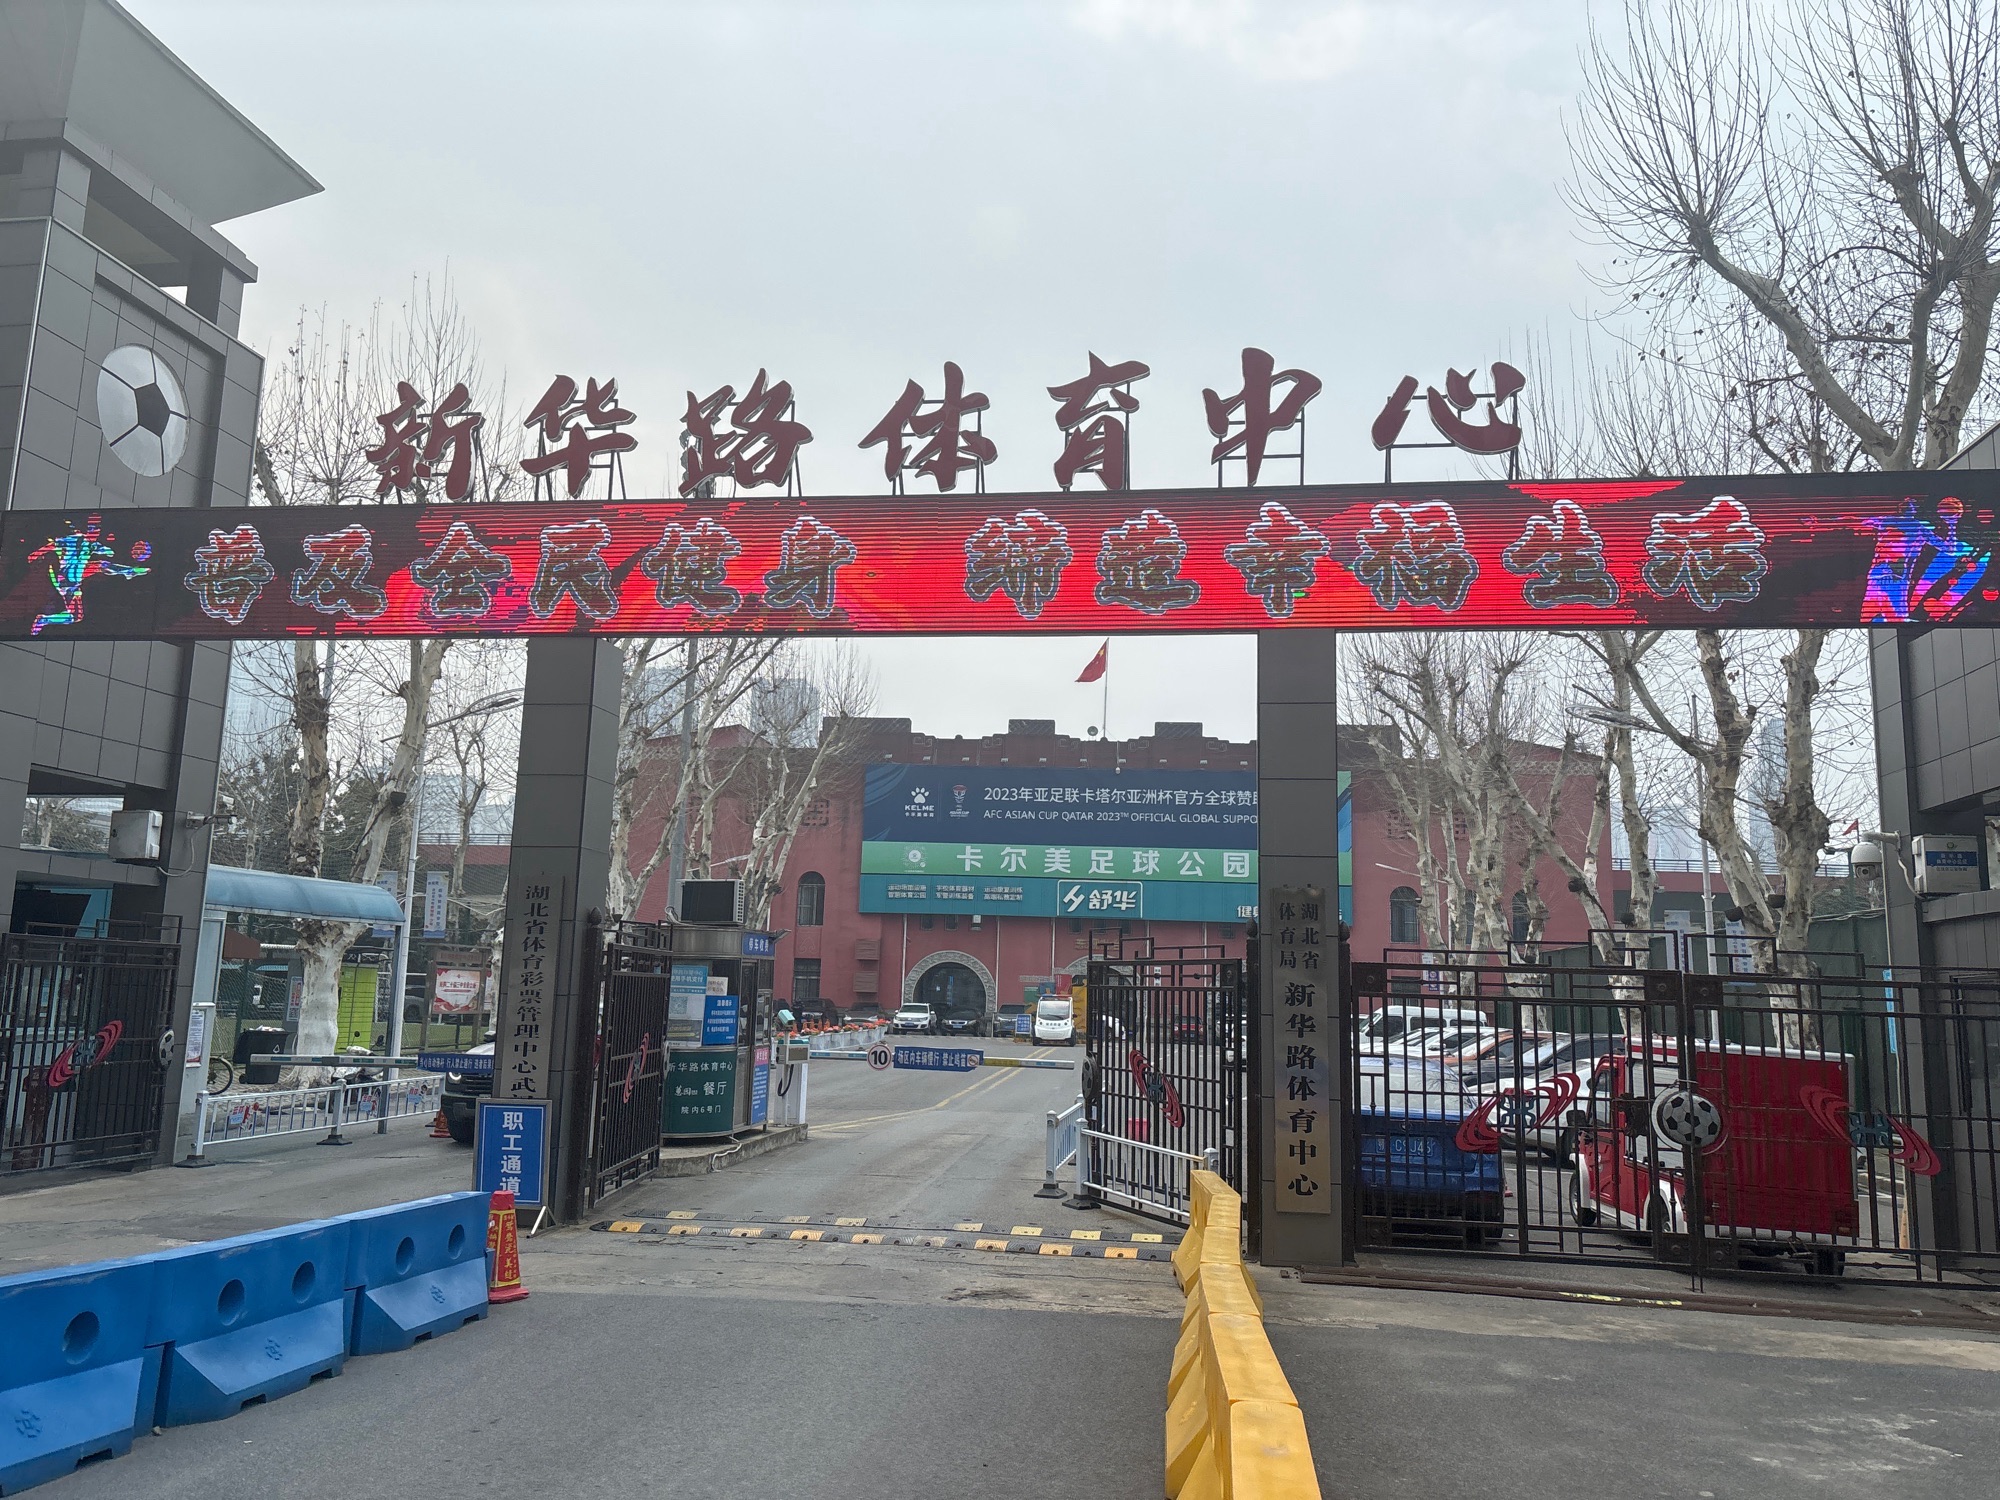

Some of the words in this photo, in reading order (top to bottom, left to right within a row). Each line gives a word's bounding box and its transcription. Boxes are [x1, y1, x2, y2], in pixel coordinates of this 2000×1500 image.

[366, 348, 1526, 500] 新华路体育中心
[186, 514, 859, 626] 普及全民健身
[964, 494, 1770, 620] 缔造幸福生活
[904, 804, 935, 812] KELME
[983, 809, 1003, 820] AFC
[1005, 810, 1036, 820] ASIAN
[1038, 811, 1059, 821] CUP
[1061, 811, 1094, 822] QATAR
[1130, 812, 1177, 824] OFFICIAL
[1179, 813, 1221, 824] GLOBAL
[956, 844, 1250, 878] 卡尔美足球公园
[1088, 888, 1137, 912] 舒华
[1279, 902, 1297, 970] 体育局
[1301, 902, 1320, 970] 湖北省
[870, 1050, 888, 1066] 10
[897, 1049, 940, 1067] 场区内车辆慢行
[942, 1052, 966, 1068] 禁止鸣笛
[703, 1081, 727, 1096] 餐厅
[1284, 981, 1320, 1198] 新华路体育中心
[680, 1104, 721, 1115] 院内6号门
[500, 1110, 524, 1196] 职工通道
